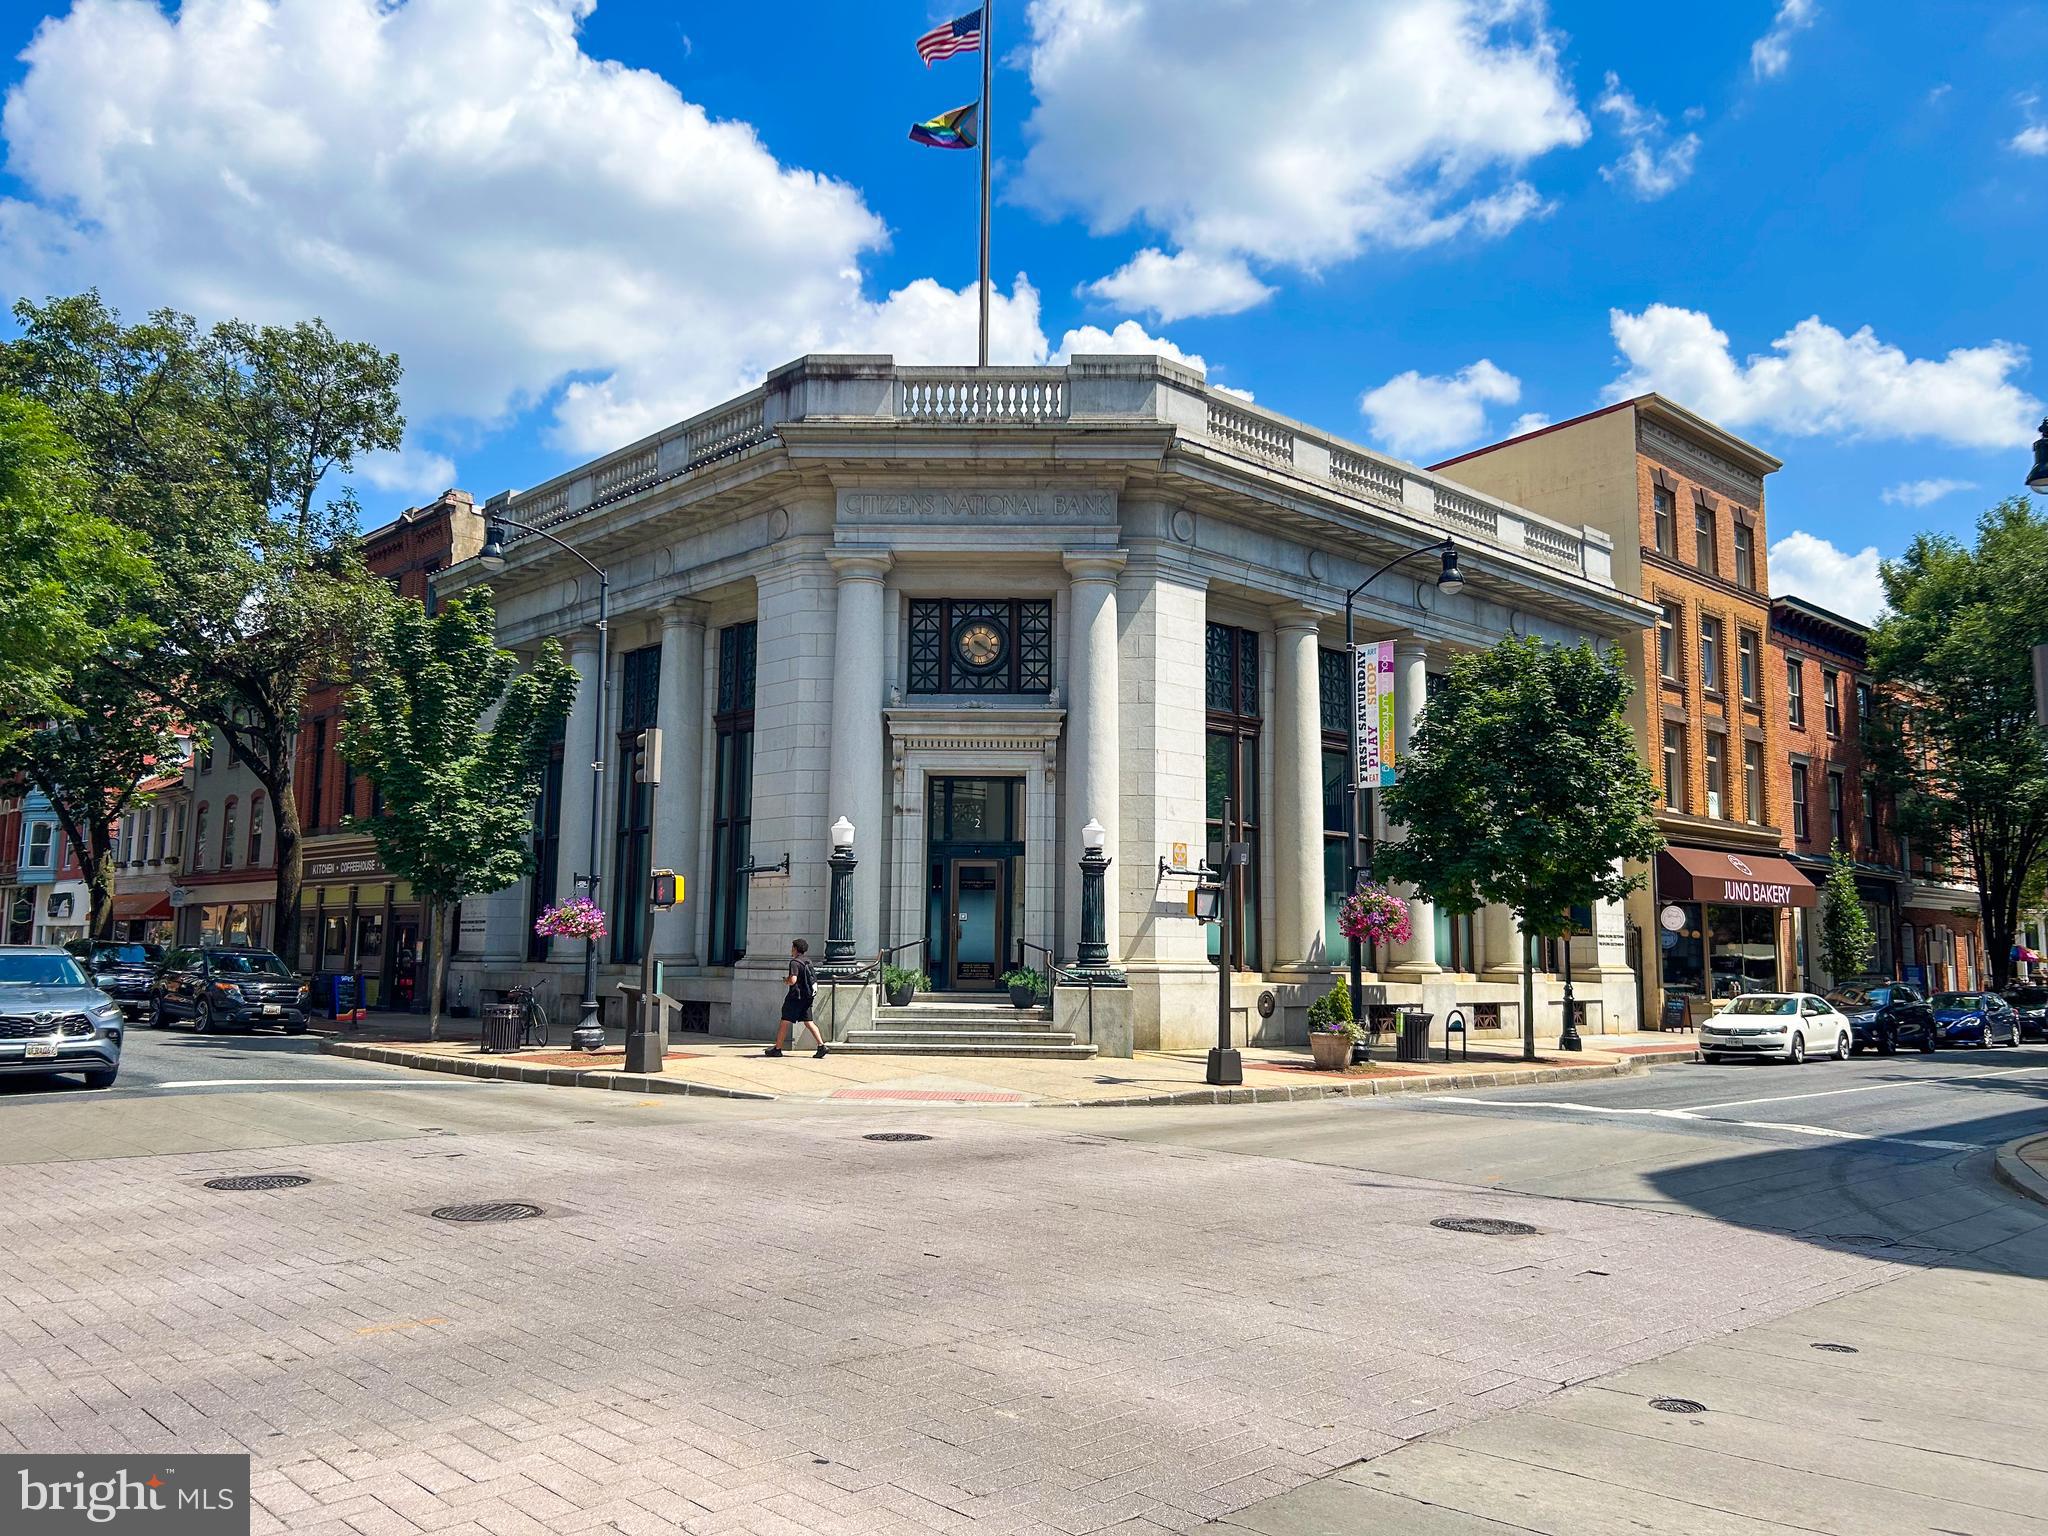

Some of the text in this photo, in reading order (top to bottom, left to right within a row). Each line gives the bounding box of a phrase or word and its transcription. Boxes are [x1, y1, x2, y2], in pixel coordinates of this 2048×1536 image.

[844, 494, 1111, 516] CITIZENS NATIONAL BANK
[1367, 662, 1377, 705] SHOP
[1357, 650, 1368, 783] FIRST SATURDAY
[1368, 725, 1379, 768] PLAY
[975, 818, 981, 828] 2
[312, 863, 335, 875] KITCHEN
[340, 860, 376, 873] COFFEEHOUSE
[1724, 880, 1791, 904] JUNO BAKERY
